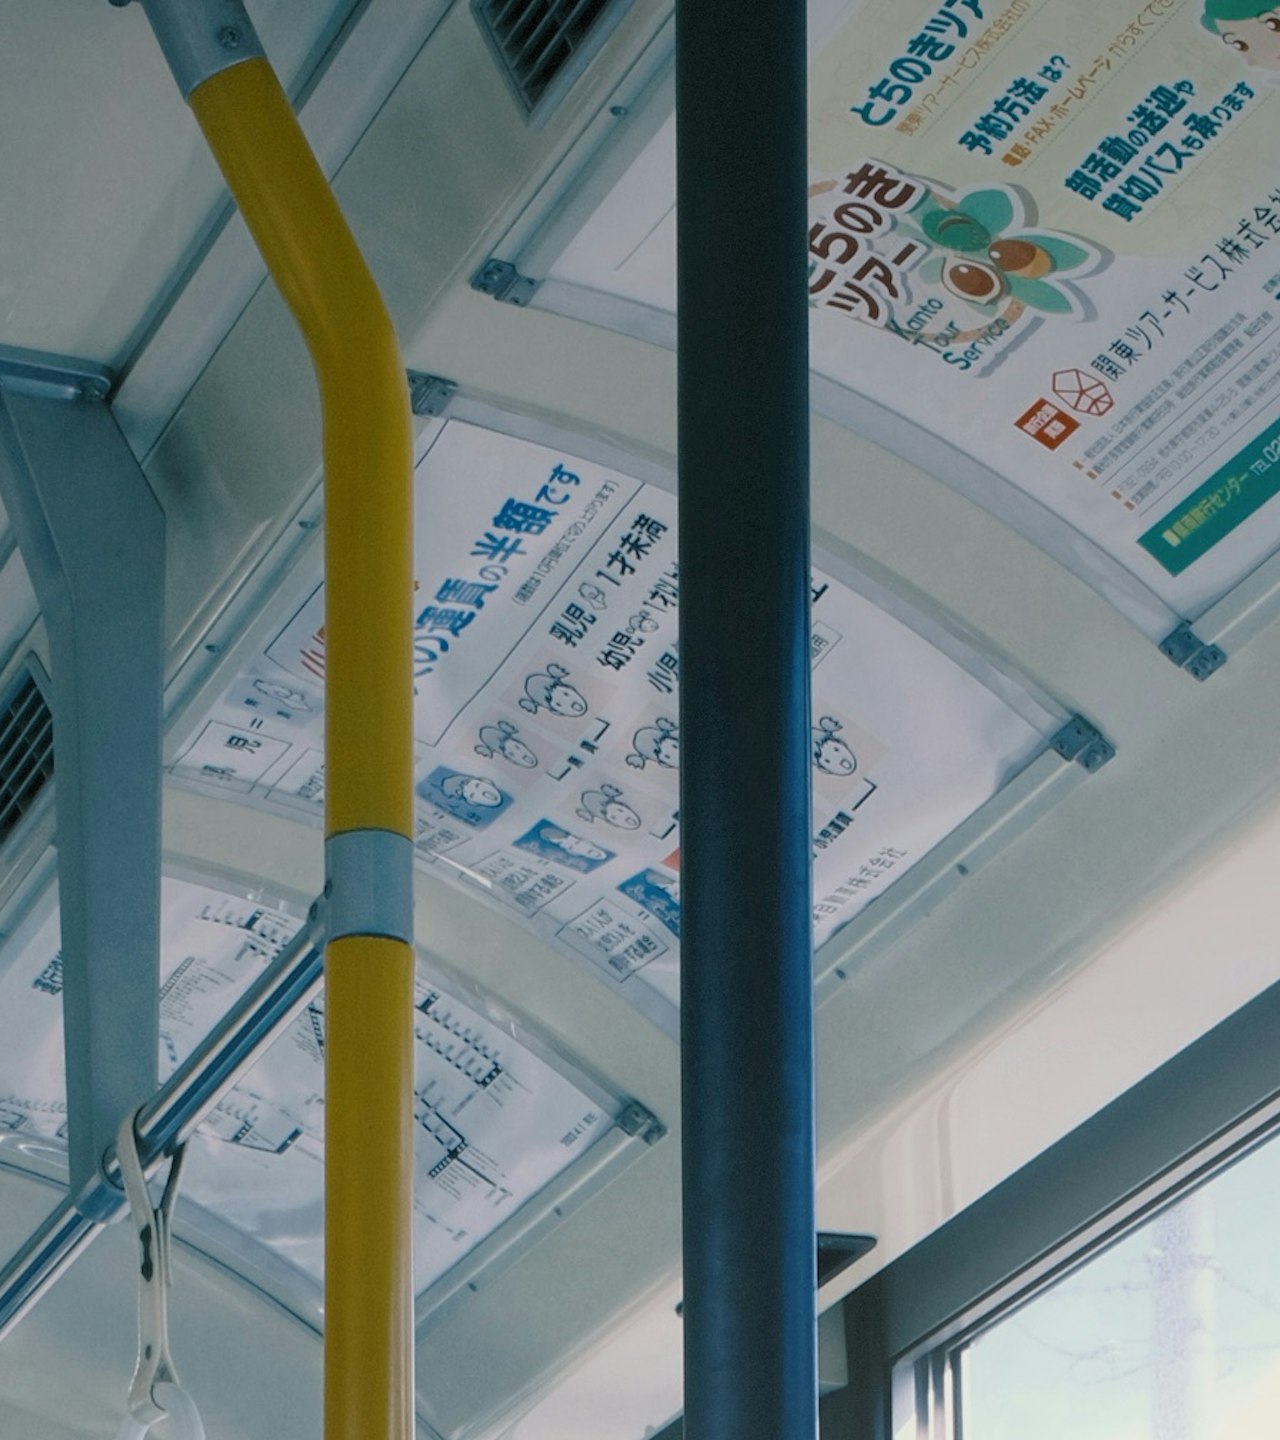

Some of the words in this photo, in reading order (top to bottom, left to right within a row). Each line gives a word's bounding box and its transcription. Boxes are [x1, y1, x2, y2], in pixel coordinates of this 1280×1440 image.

[1064, 78, 1196, 201] 部活動の送迎や
[1101, 80, 1257, 223] 貸切バスも承ります
[825, 242, 919, 322] ツアー
[889, 297, 944, 343] Kanto
[913, 319, 963, 355] Tour
[942, 317, 1010, 372] Service
[548, 602, 597, 648] 乳児
[596, 512, 669, 587] 1才未満
[596, 630, 645, 672] 幼児
